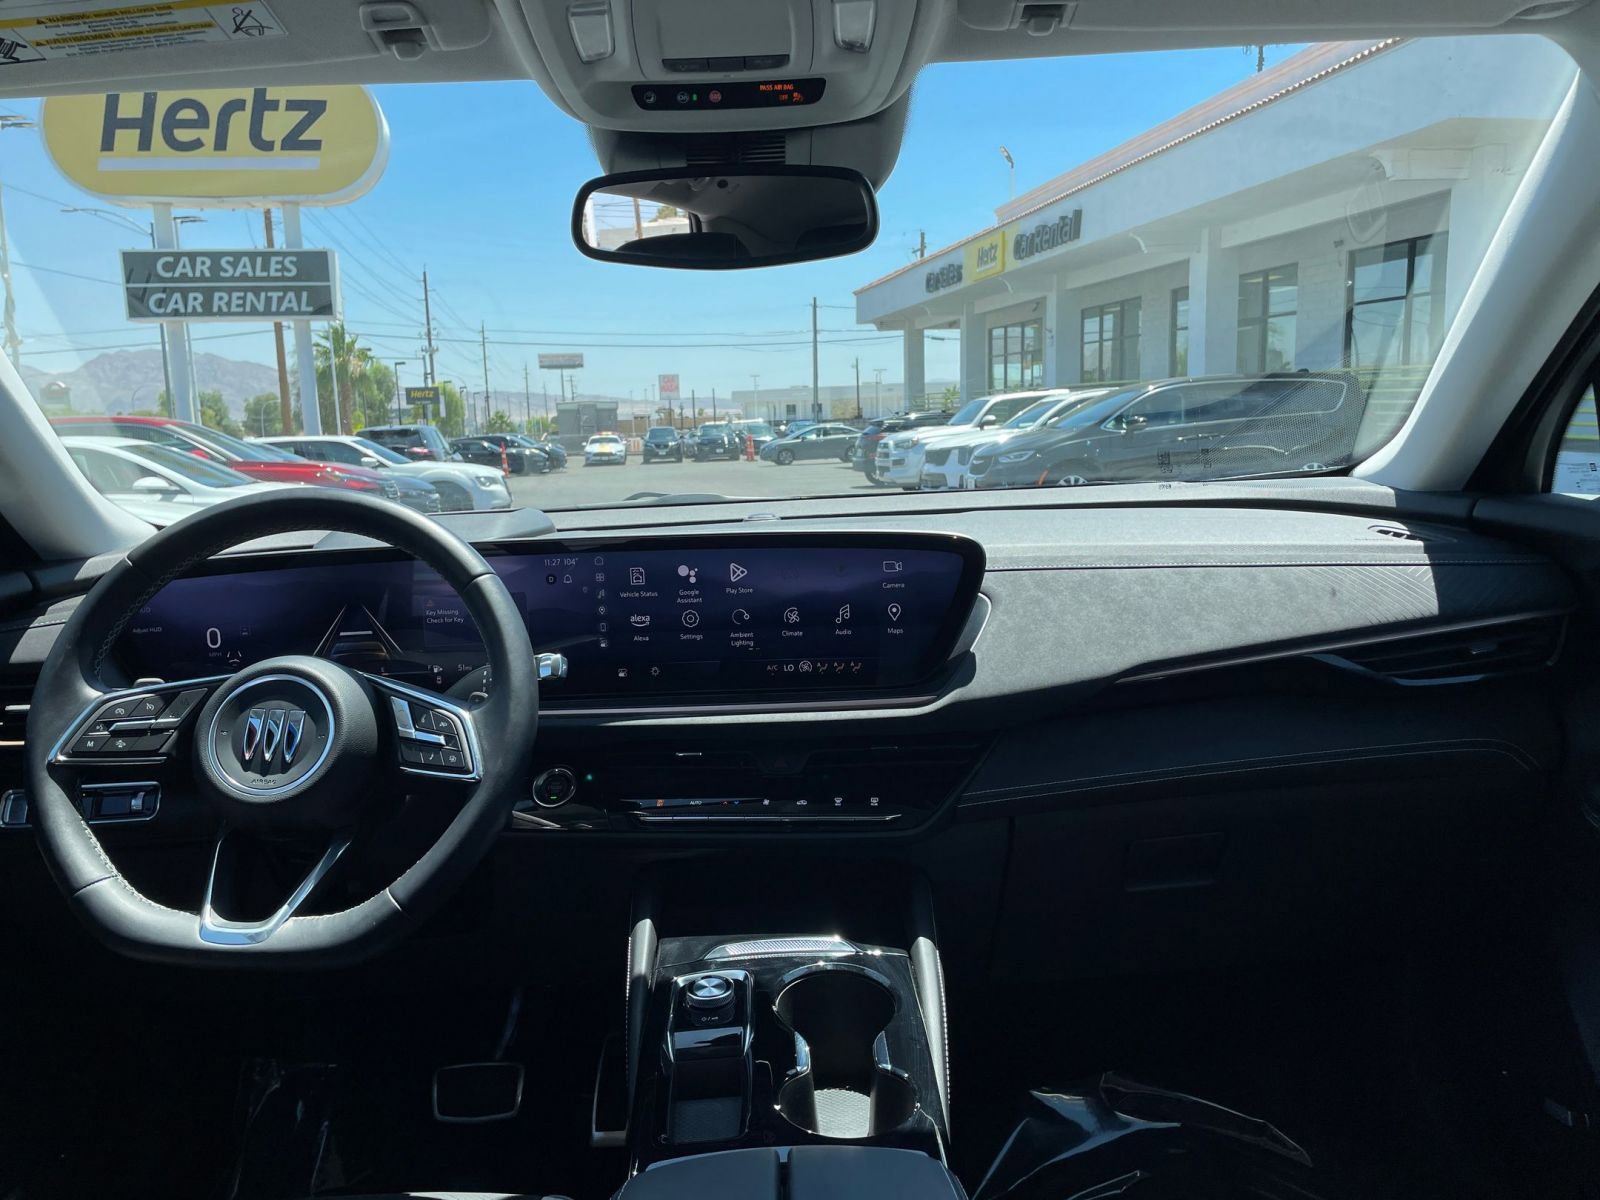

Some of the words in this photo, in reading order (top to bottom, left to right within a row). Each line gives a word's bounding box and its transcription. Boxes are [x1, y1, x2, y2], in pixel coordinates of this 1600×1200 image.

[99, 87, 328, 152] Hertz
[1013, 232, 1035, 261] Car
[1034, 208, 1083, 253] Rental
[976, 242, 998, 269] Hertz
[156, 256, 210, 278] CAR
[220, 256, 298, 278] SALES
[148, 292, 204, 313] CAR
[213, 291, 313, 312] RENTAL
[410, 390, 434, 399] Hertz
[544, 558, 561, 566] 11:27
[436, 608, 459, 616] Missing
[206, 627, 222, 649] 0
